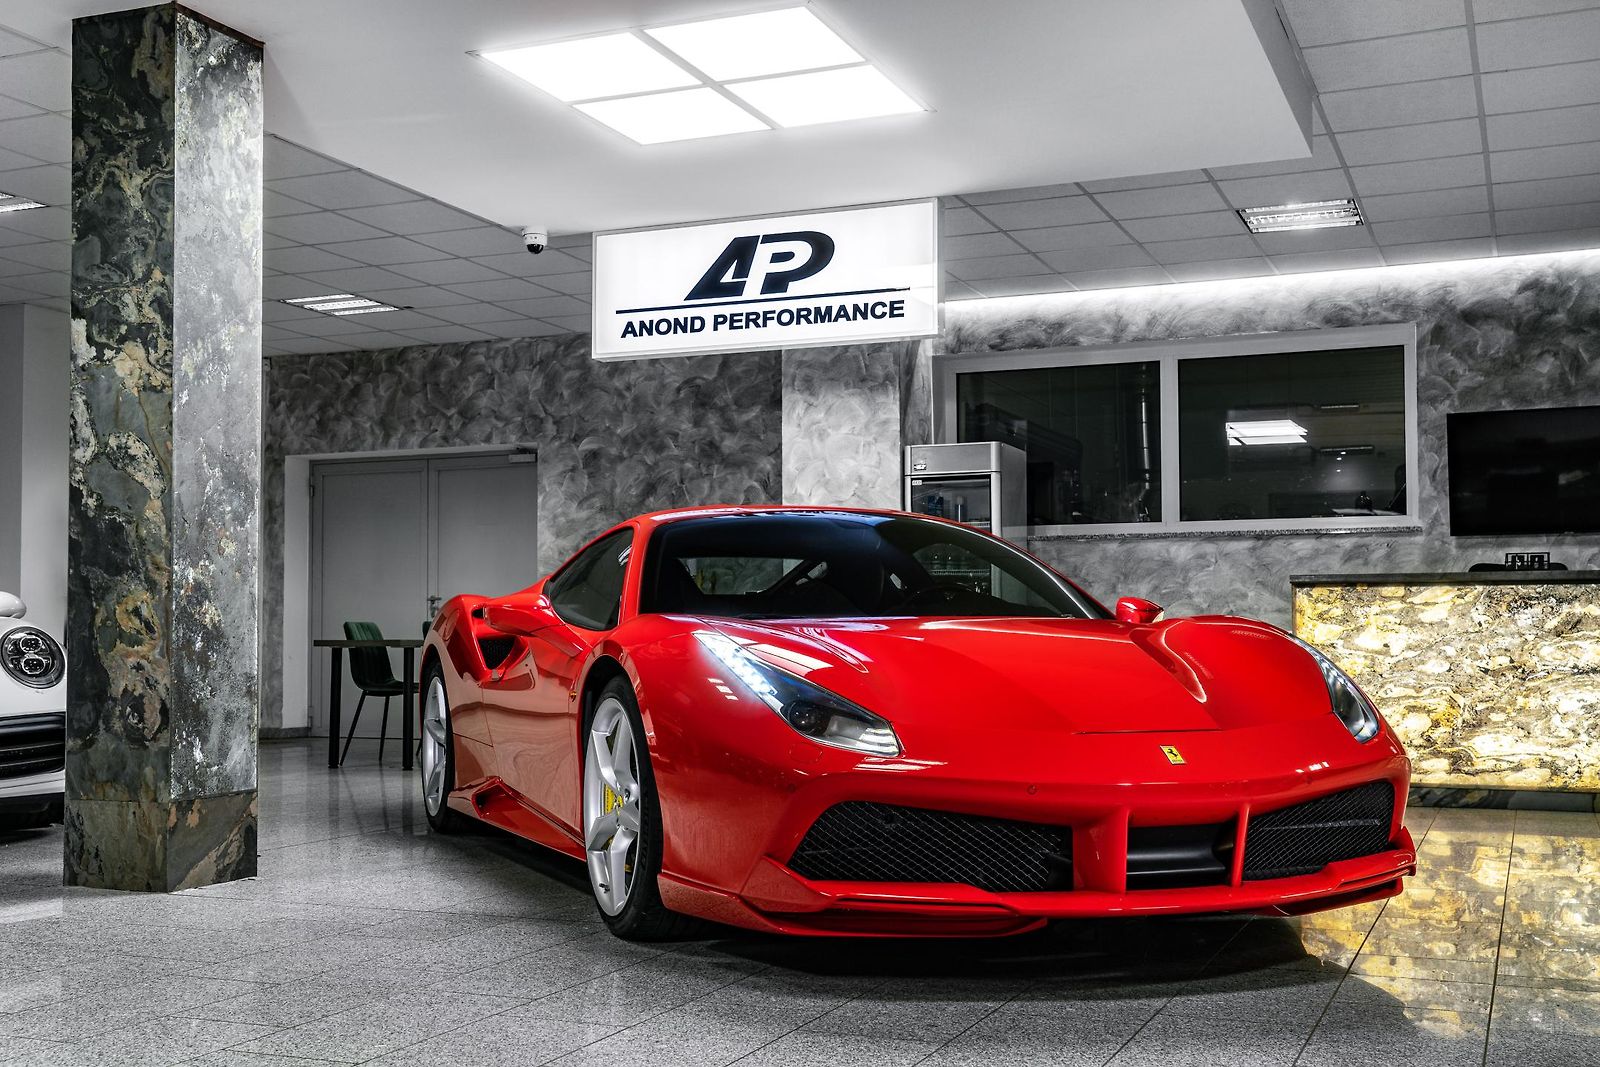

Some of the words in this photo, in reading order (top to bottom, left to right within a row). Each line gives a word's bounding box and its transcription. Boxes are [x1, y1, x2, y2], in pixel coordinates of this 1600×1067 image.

[684, 230, 835, 301] AP
[621, 315, 706, 339] ANOND
[713, 299, 905, 332] PERFORMANCE
